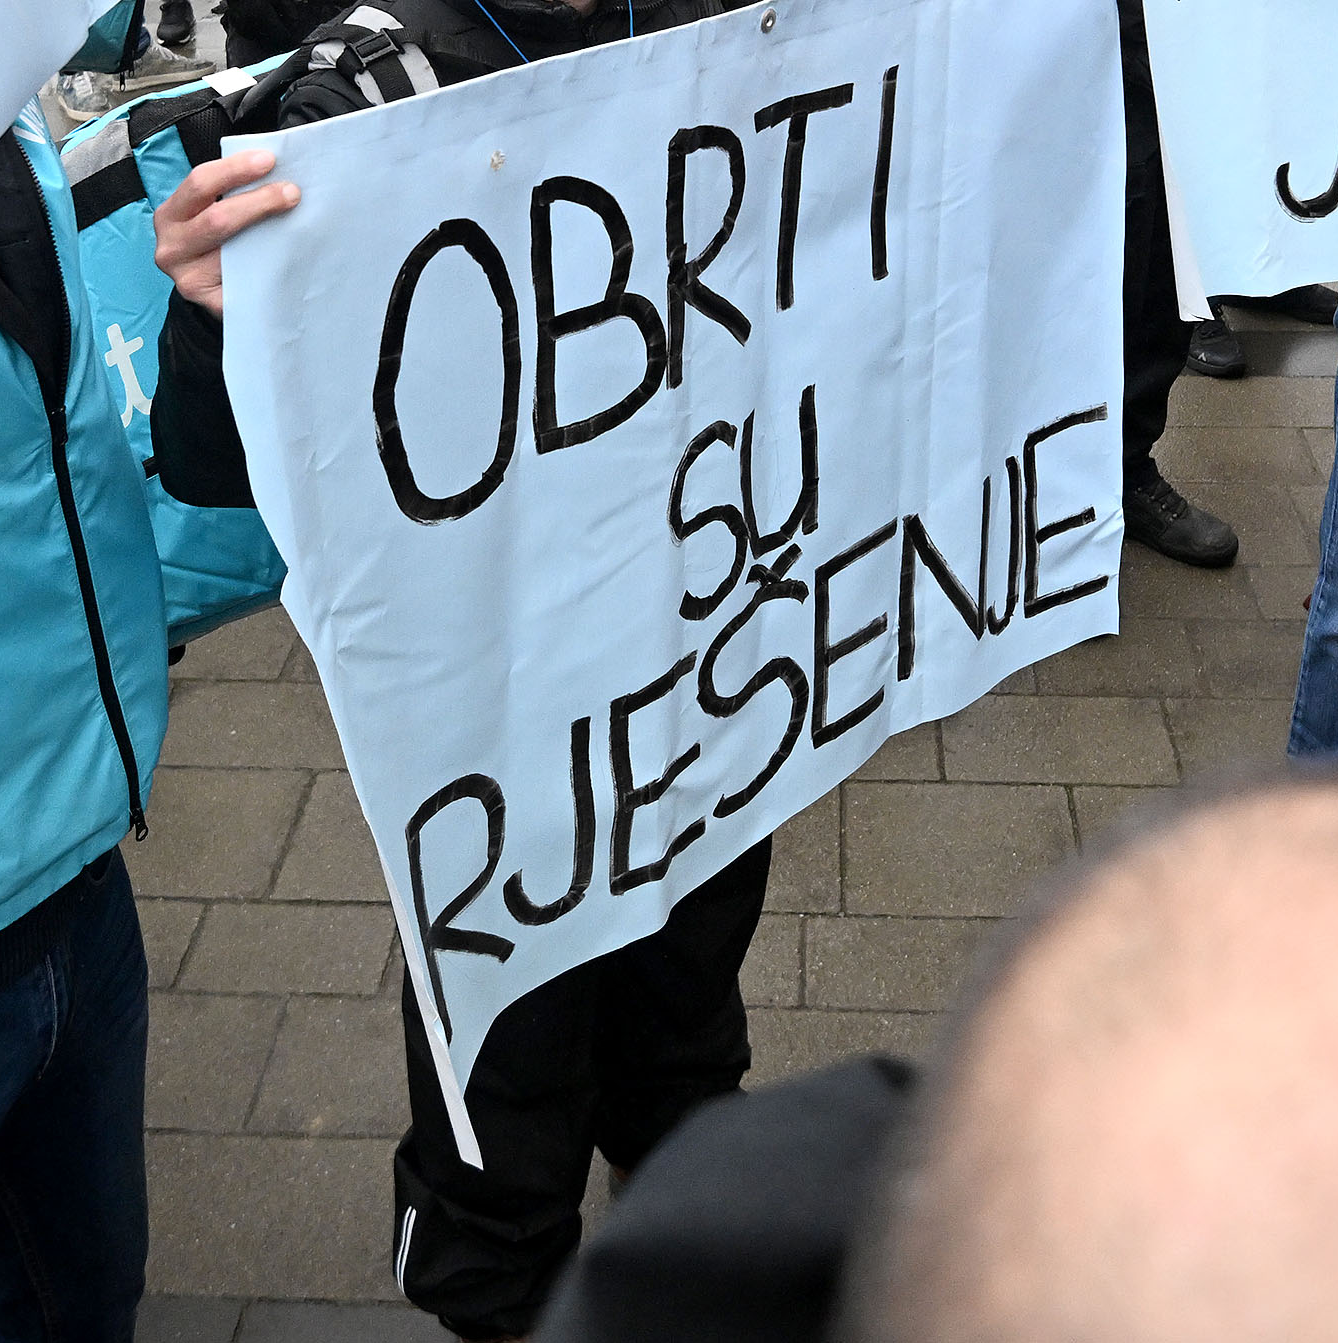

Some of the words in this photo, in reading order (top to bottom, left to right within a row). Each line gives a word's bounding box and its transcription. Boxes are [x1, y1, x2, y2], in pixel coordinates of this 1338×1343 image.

[372, 64, 899, 525] OBRTI
[668, 383, 819, 621] SU
[404, 403, 1110, 1047] RJEŠENJE
